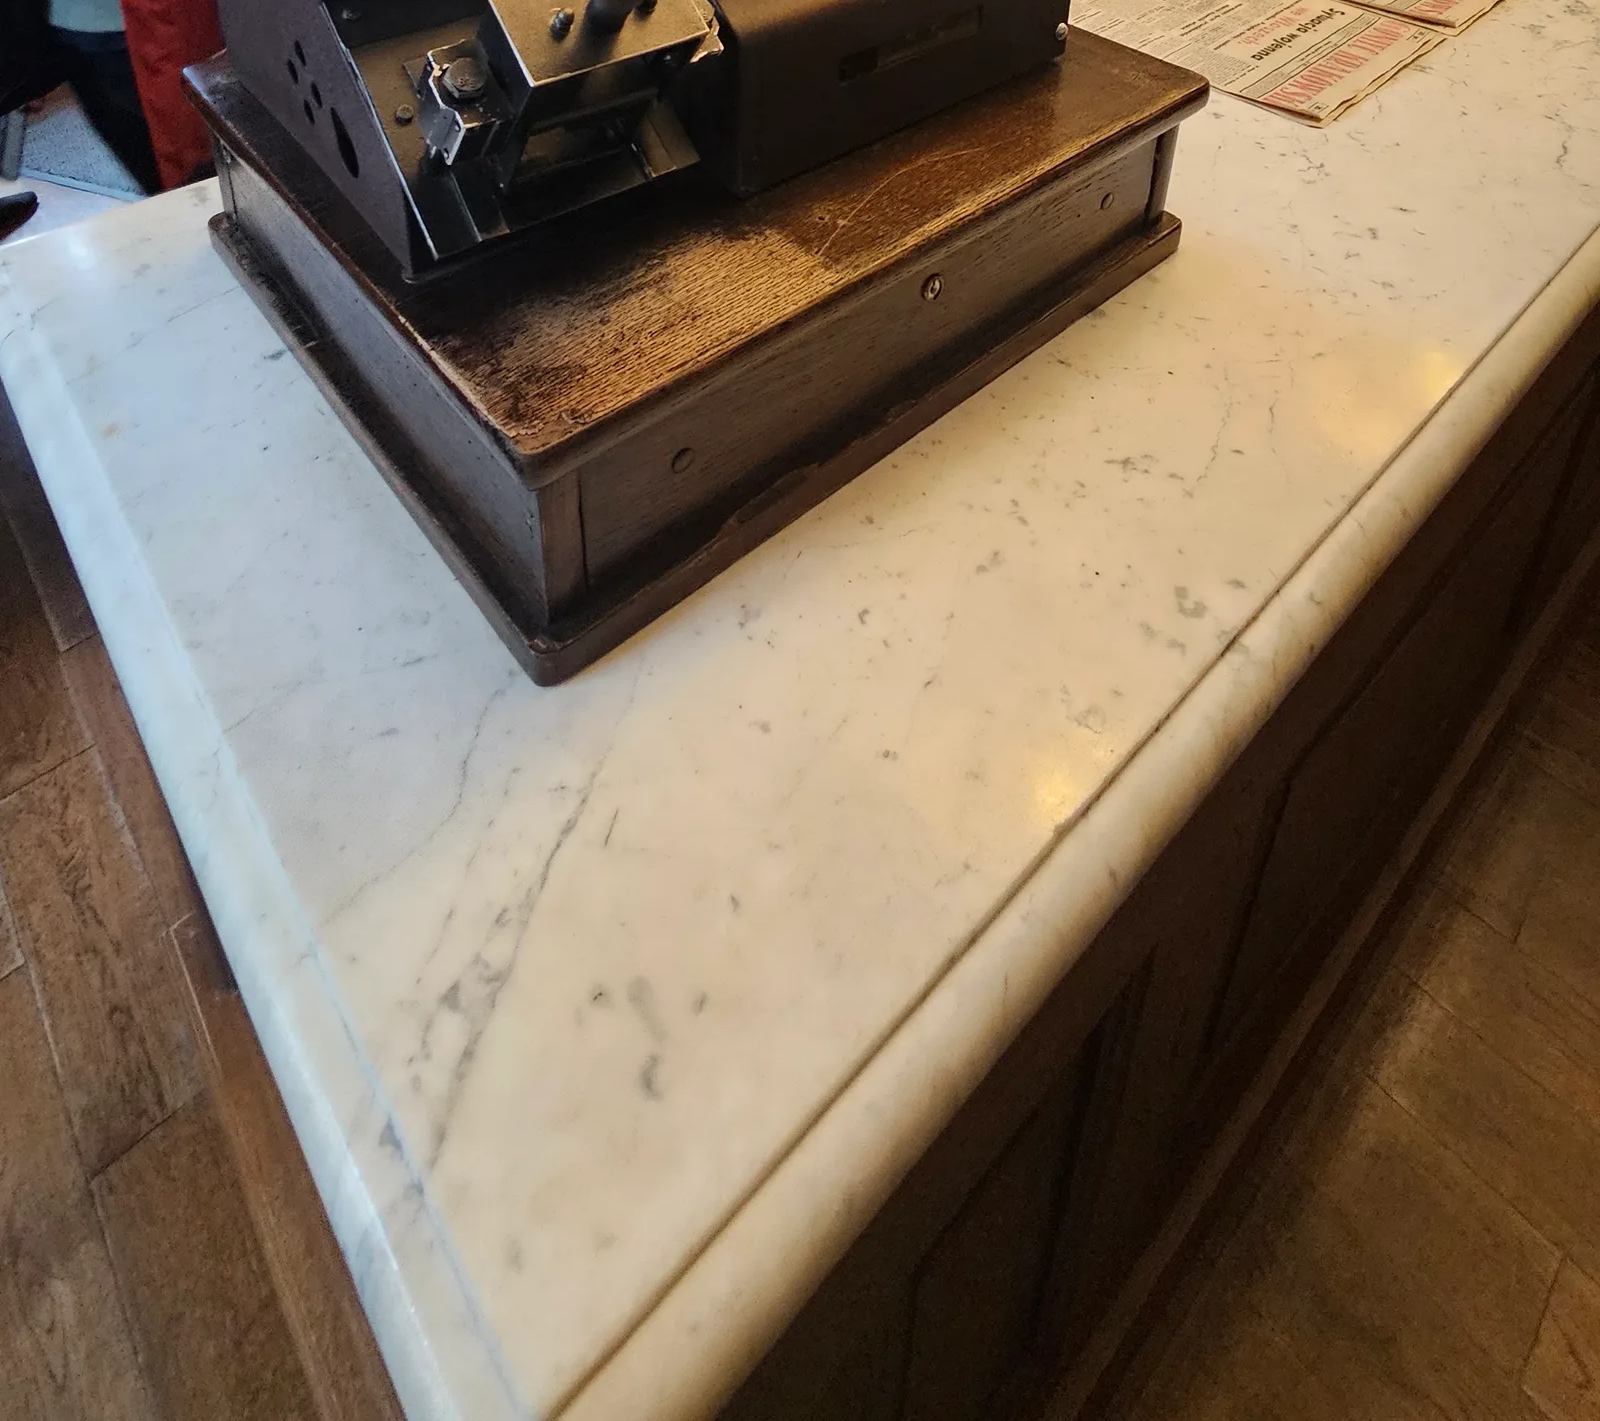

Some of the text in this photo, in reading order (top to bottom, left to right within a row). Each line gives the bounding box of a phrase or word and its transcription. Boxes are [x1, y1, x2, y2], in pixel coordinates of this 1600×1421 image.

[1297, 7, 1347, 33] Sytuacja
[1250, 32, 1301, 62] wojenna
[1347, 18, 1414, 57] GONIEC
